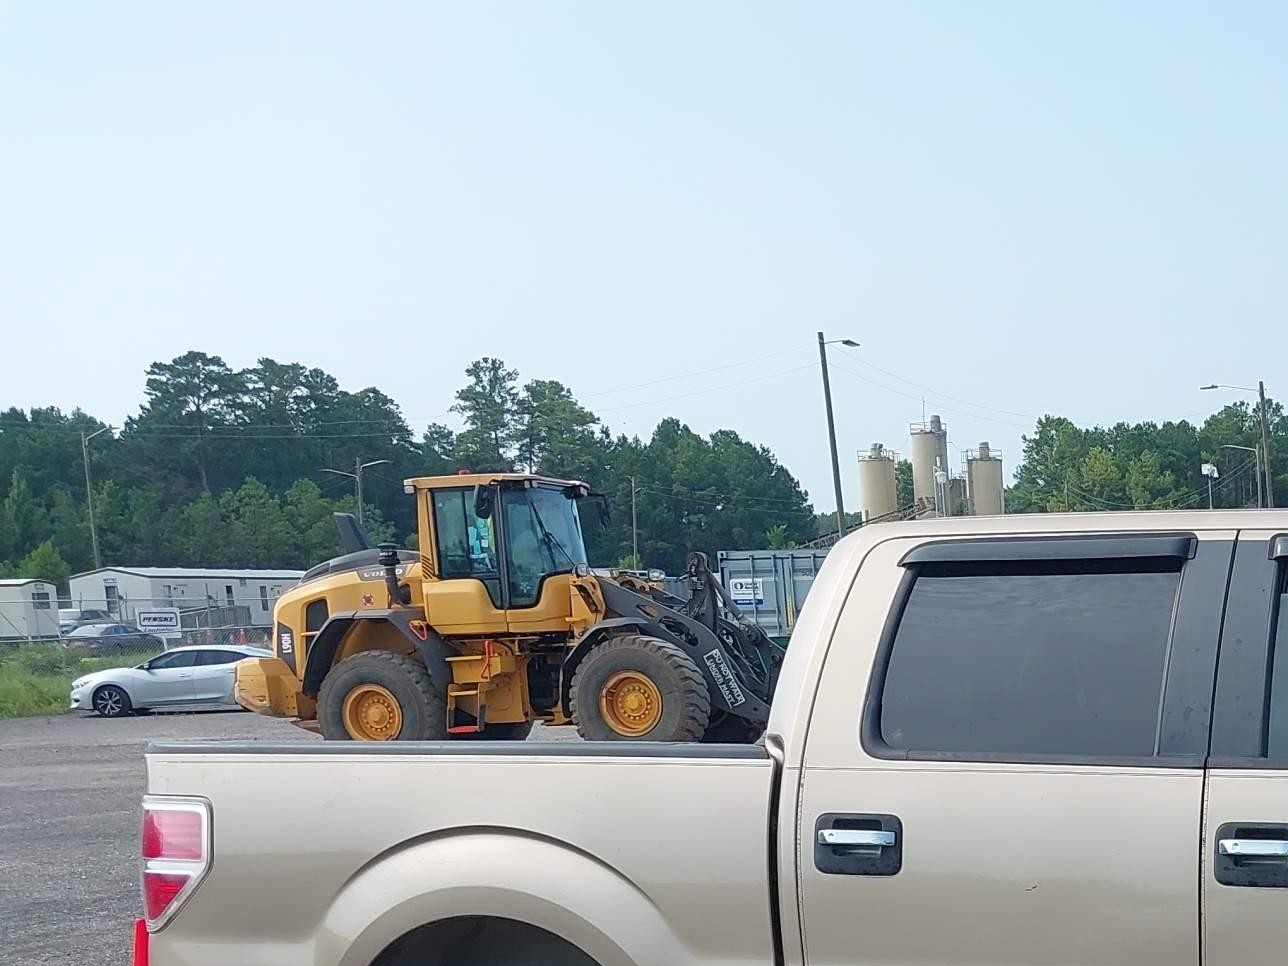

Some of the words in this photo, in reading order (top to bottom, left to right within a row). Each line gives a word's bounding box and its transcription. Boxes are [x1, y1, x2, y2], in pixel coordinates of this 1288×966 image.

[363, 569, 403, 578] VOLO
[280, 632, 293, 654] L90H
[719, 663, 733, 681] NOT
